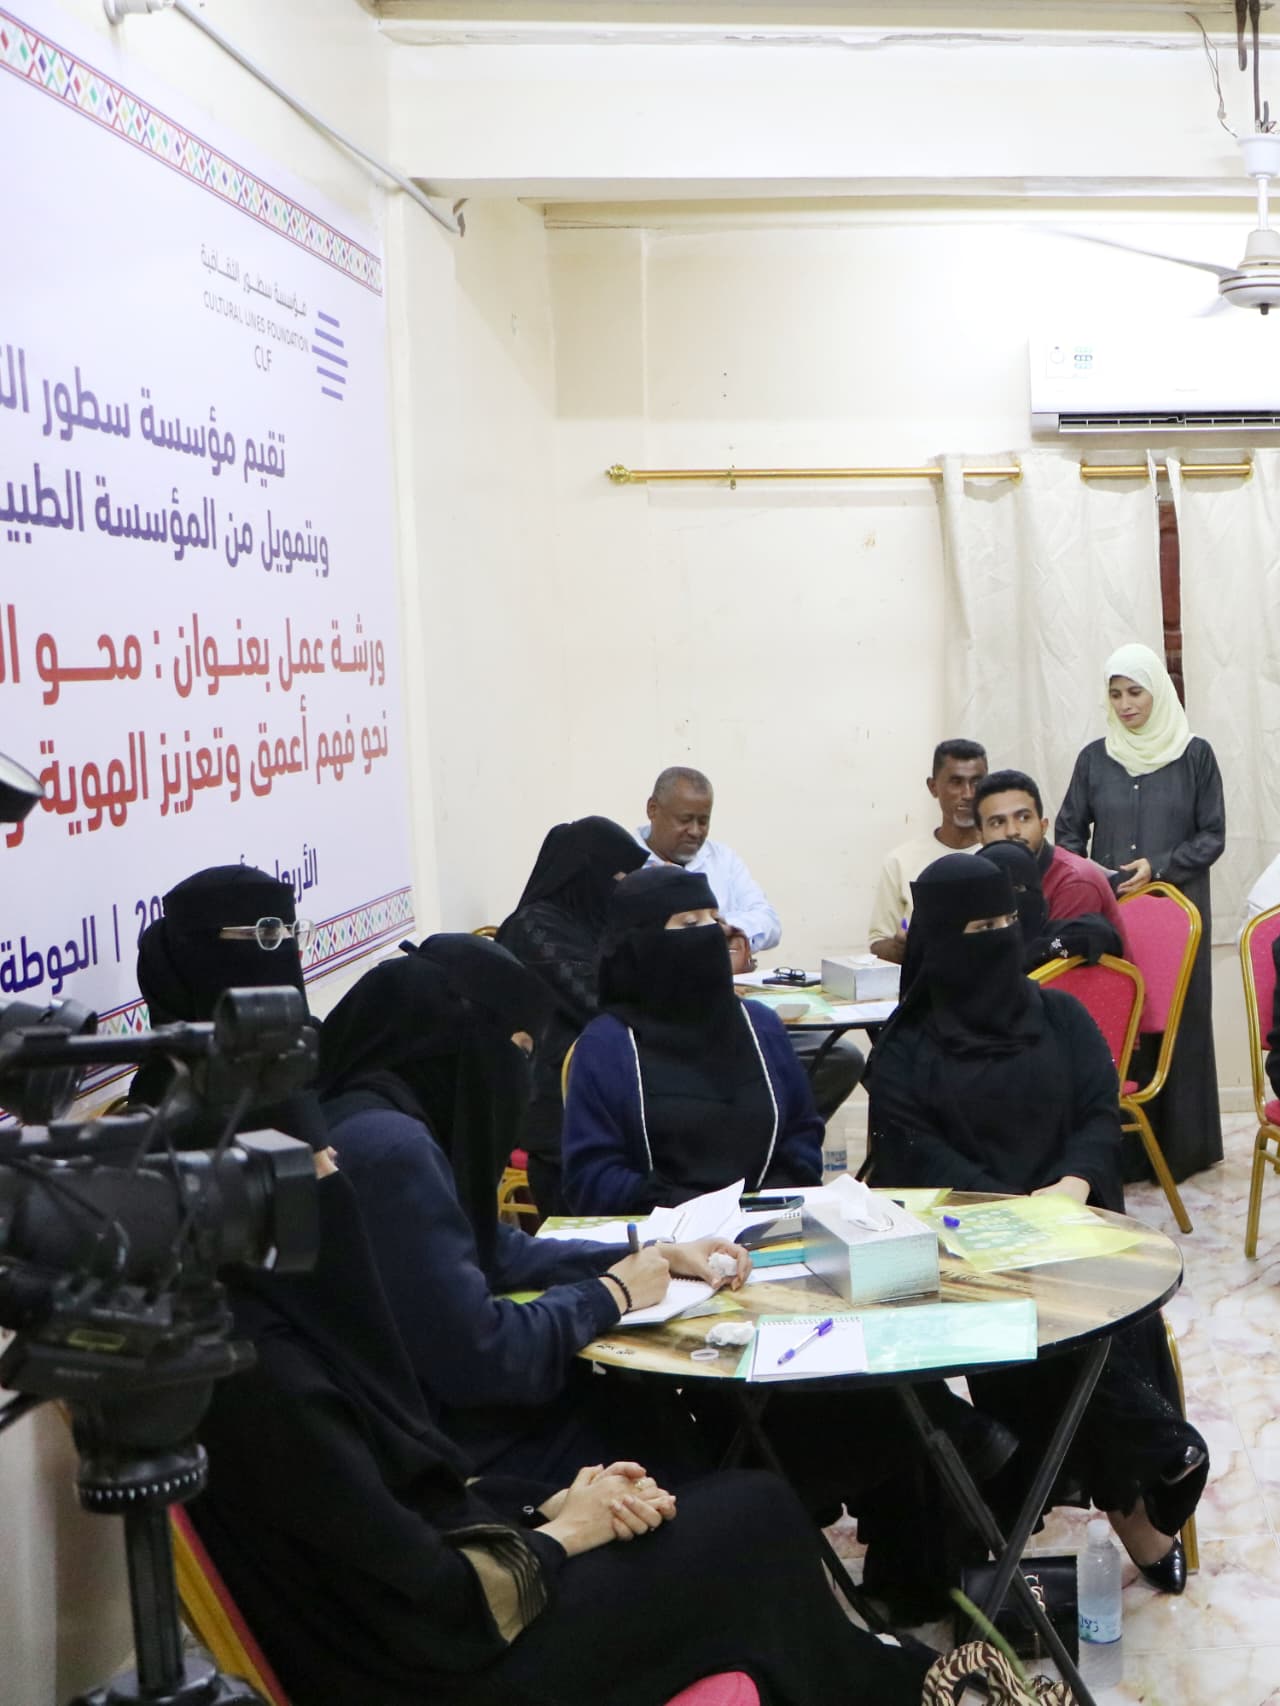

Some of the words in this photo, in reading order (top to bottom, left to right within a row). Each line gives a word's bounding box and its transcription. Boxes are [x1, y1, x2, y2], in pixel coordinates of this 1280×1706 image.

[203, 290, 243, 324] CULTURAL
[244, 311, 266, 333] LINES
[267, 320, 309, 353] FOUNDATION
[254, 345, 272, 373] CLF
[43, 366, 131, 441] سطور
[140, 387, 236, 476] مؤسسة
[244, 430, 286, 487] تقيم
[0, 462, 85, 544] الطبي
[95, 475, 217, 560] المؤسسة
[225, 512, 253, 568] من
[261, 510, 329, 577] وبتمويل
[278, 617, 326, 691] عمل
[331, 613, 386, 686] ورشة
[160, 726, 241, 816] وتعزيز
[249, 694, 309, 796] أعمق
[315, 713, 355, 784] فهم
[360, 710, 389, 774] نحو
[39, 730, 150, 835] الهوية
[0, 915, 98, 995] الحوطة
